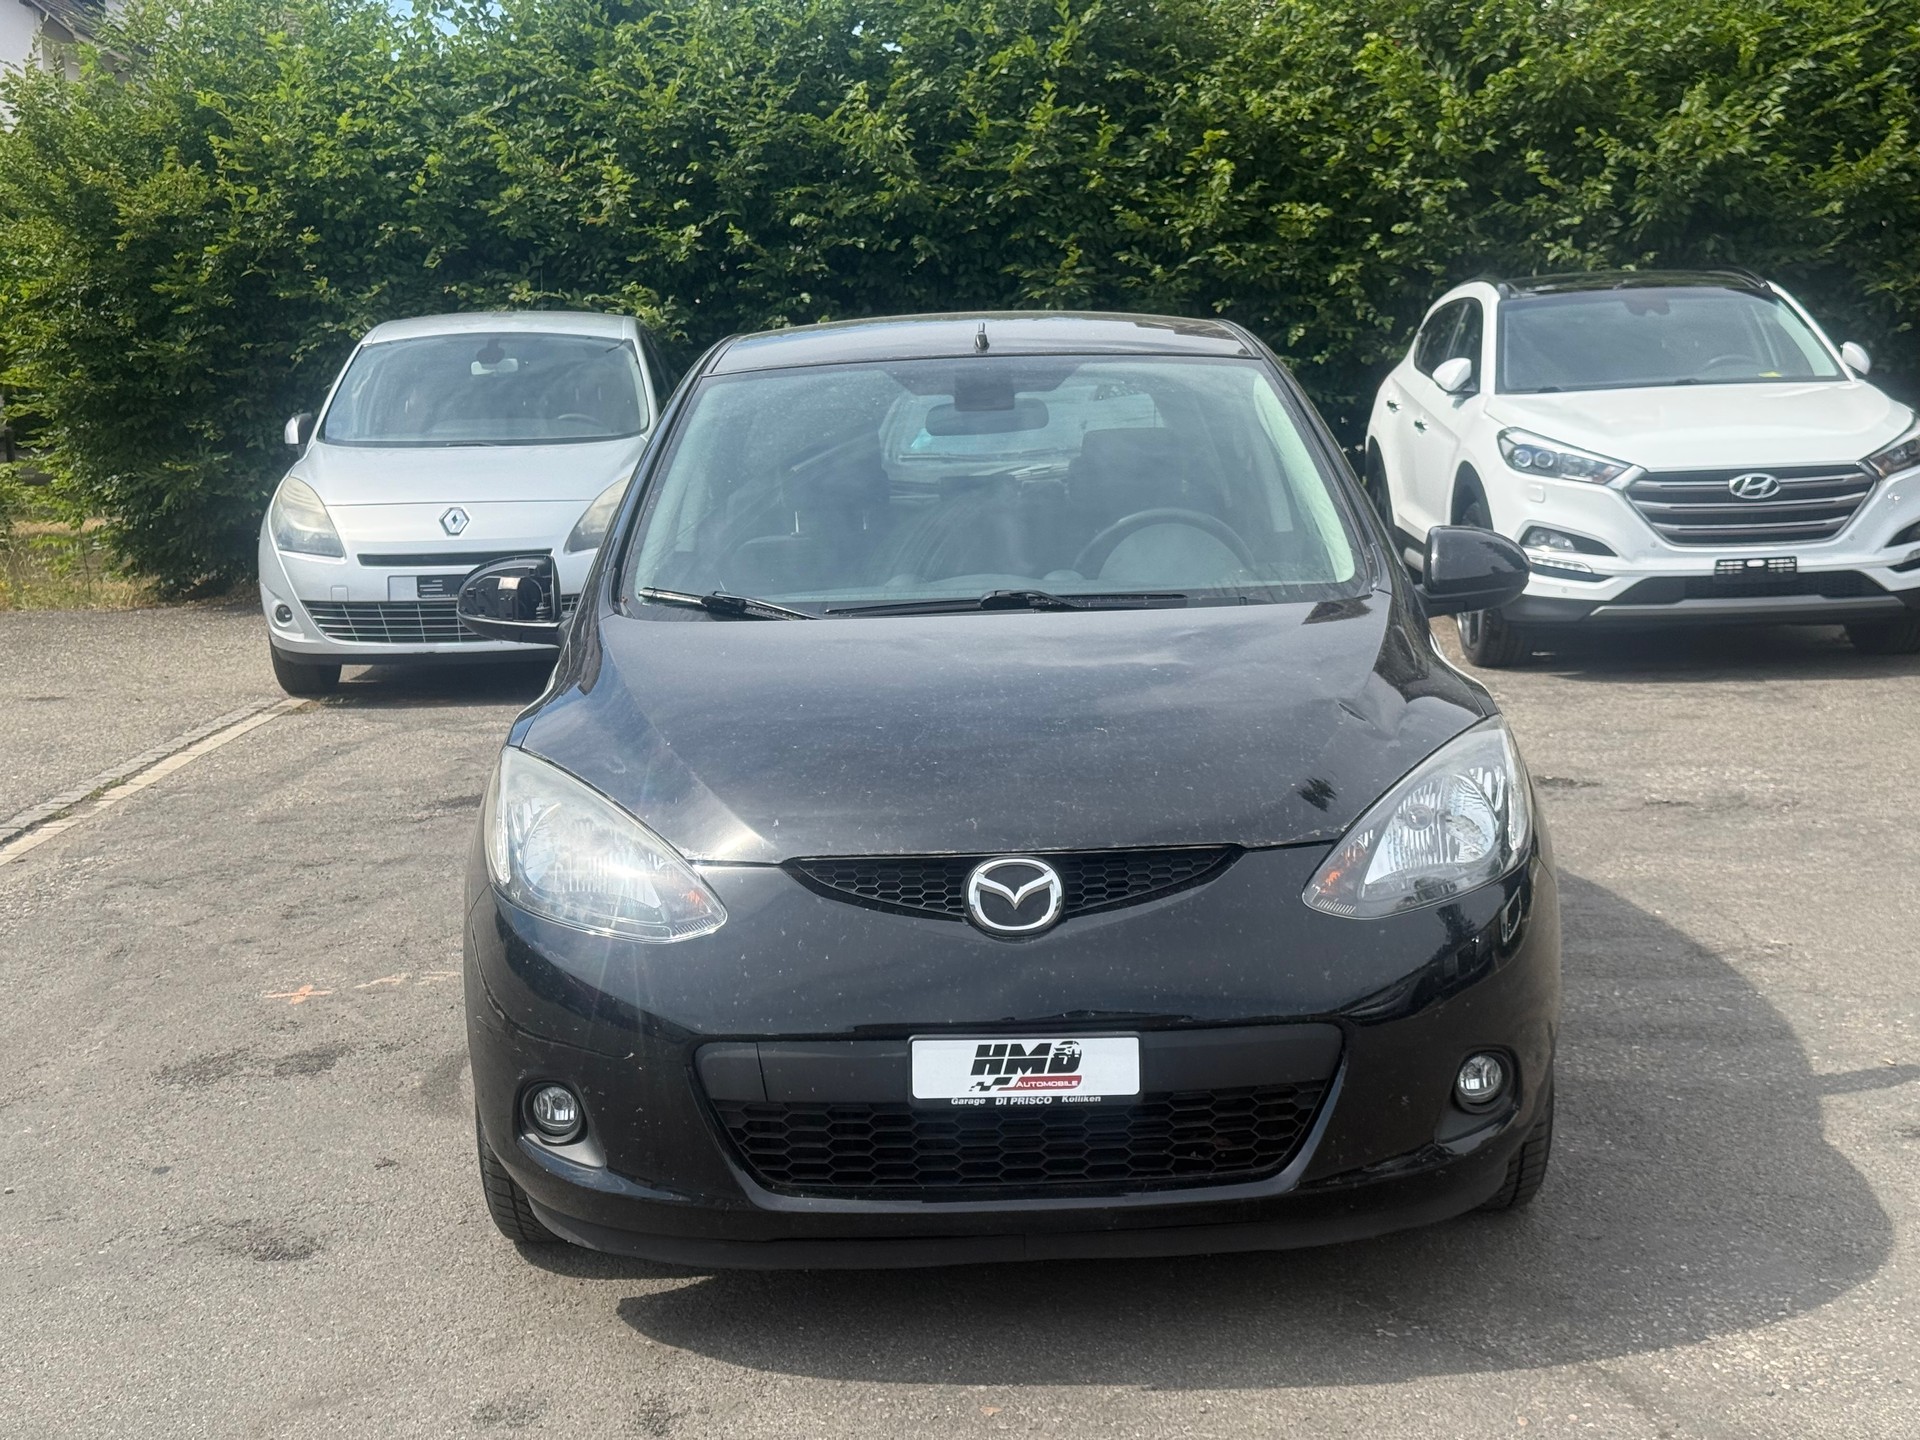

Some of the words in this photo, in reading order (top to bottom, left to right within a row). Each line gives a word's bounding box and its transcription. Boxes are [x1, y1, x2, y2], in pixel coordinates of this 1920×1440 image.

[970, 1041, 1082, 1076] HMD
[1016, 1080, 1078, 1088] AUTOMOBILE
[951, 1097, 986, 1106] Garage
[995, 1097, 1007, 1105] DI
[1010, 1096, 1053, 1105] PRISCO
